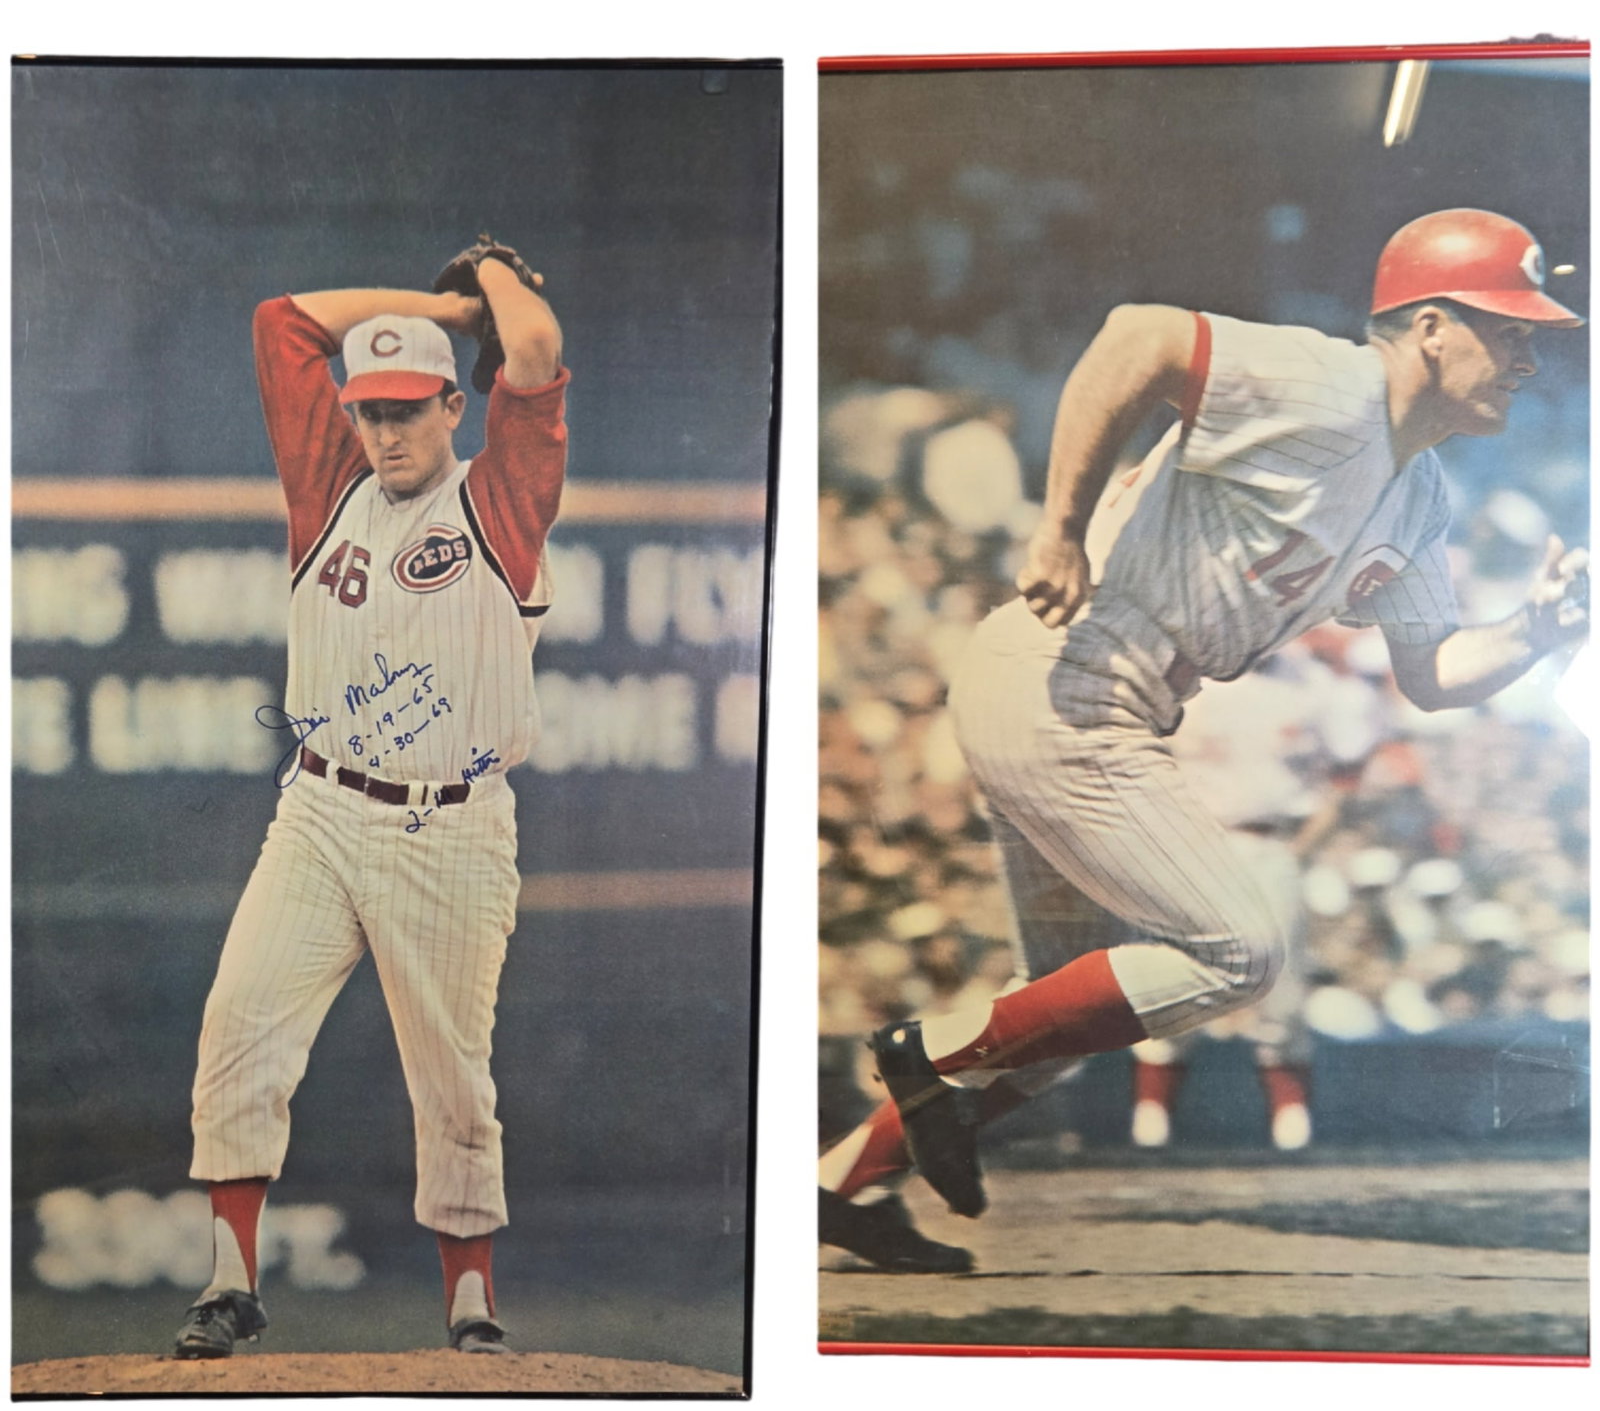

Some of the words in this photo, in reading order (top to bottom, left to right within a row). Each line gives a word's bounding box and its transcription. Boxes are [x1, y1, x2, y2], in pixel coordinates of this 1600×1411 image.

[370, 329, 403, 358] C
[318, 539, 372, 609] 46
[413, 540, 467, 575] REDS
[1244, 527, 1337, 608] 14
[348, 673, 435, 756] 8-19-65
[368, 696, 453, 769] 4-30-69
